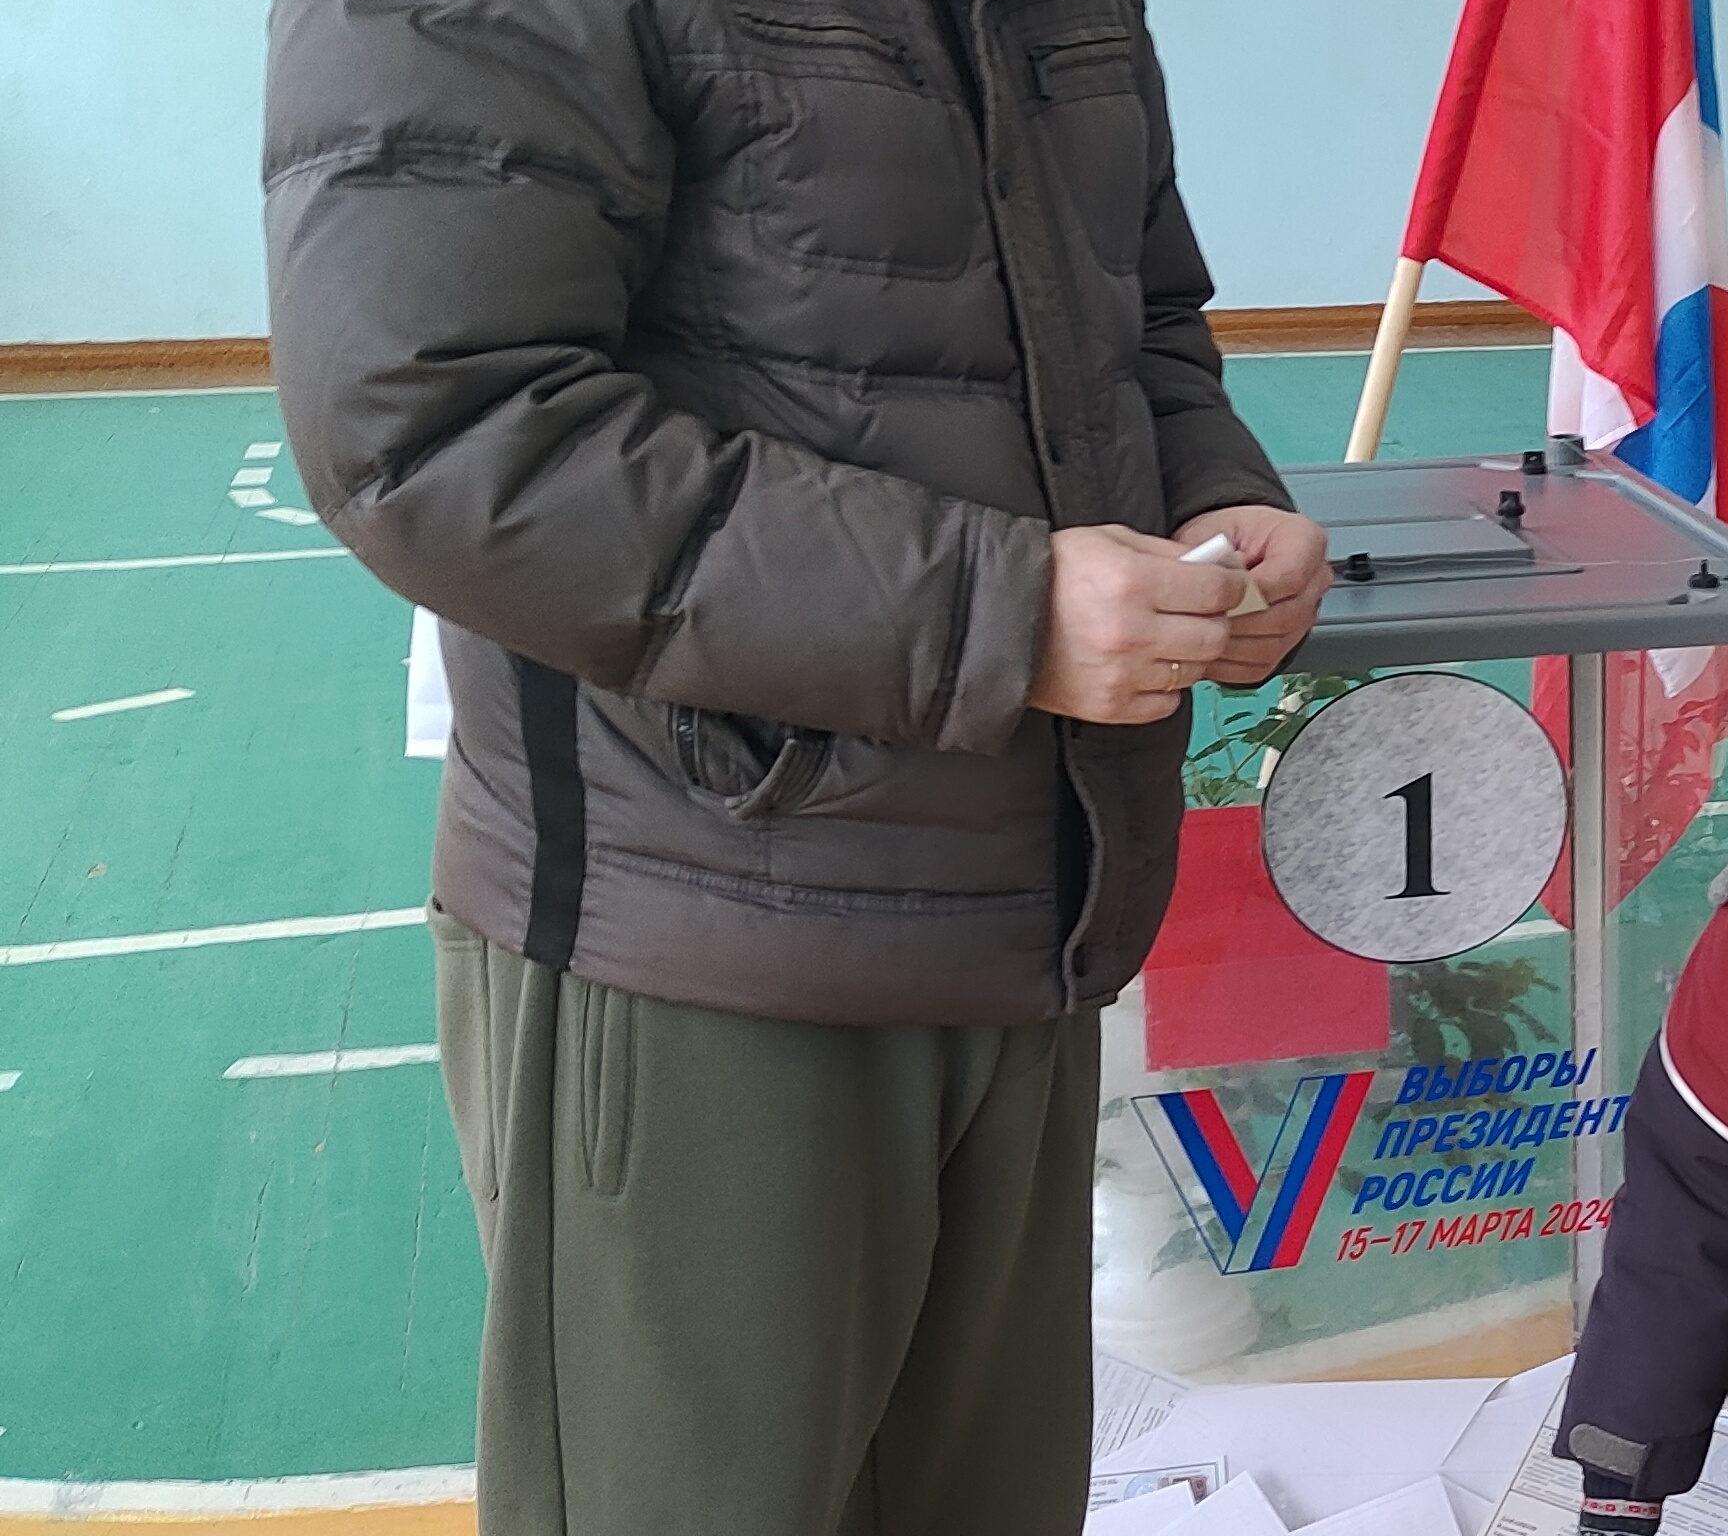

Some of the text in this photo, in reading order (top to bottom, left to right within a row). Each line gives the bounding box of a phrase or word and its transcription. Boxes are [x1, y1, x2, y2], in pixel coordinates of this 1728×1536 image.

[1382, 771, 1452, 900] 1
[1395, 1047, 1598, 1105] ВЫБОРЫ
[1373, 1095, 1632, 1160] ПРЕЗИДЕНТ
[1351, 1156, 1536, 1215] РОССИИ
[1427, 1207, 1535, 1251] МАРТА
[1539, 1197, 1615, 1238] 2024
